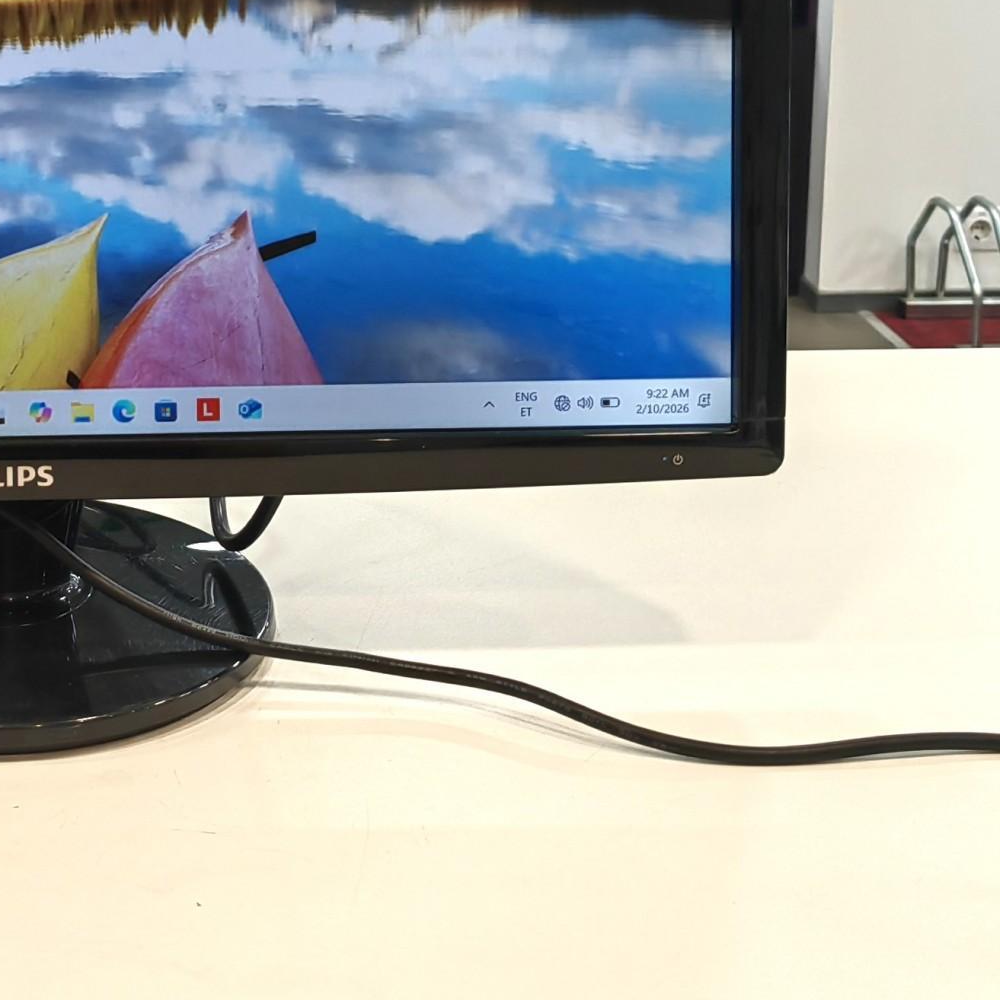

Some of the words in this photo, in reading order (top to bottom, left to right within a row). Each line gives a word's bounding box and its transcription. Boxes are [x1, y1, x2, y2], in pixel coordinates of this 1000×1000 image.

[515, 391, 538, 402] ENG
[646, 388, 669, 399] 9:22
[671, 387, 690, 398] AM
[520, 407, 532, 417] ET
[636, 403, 690, 414] 2/10/2026
